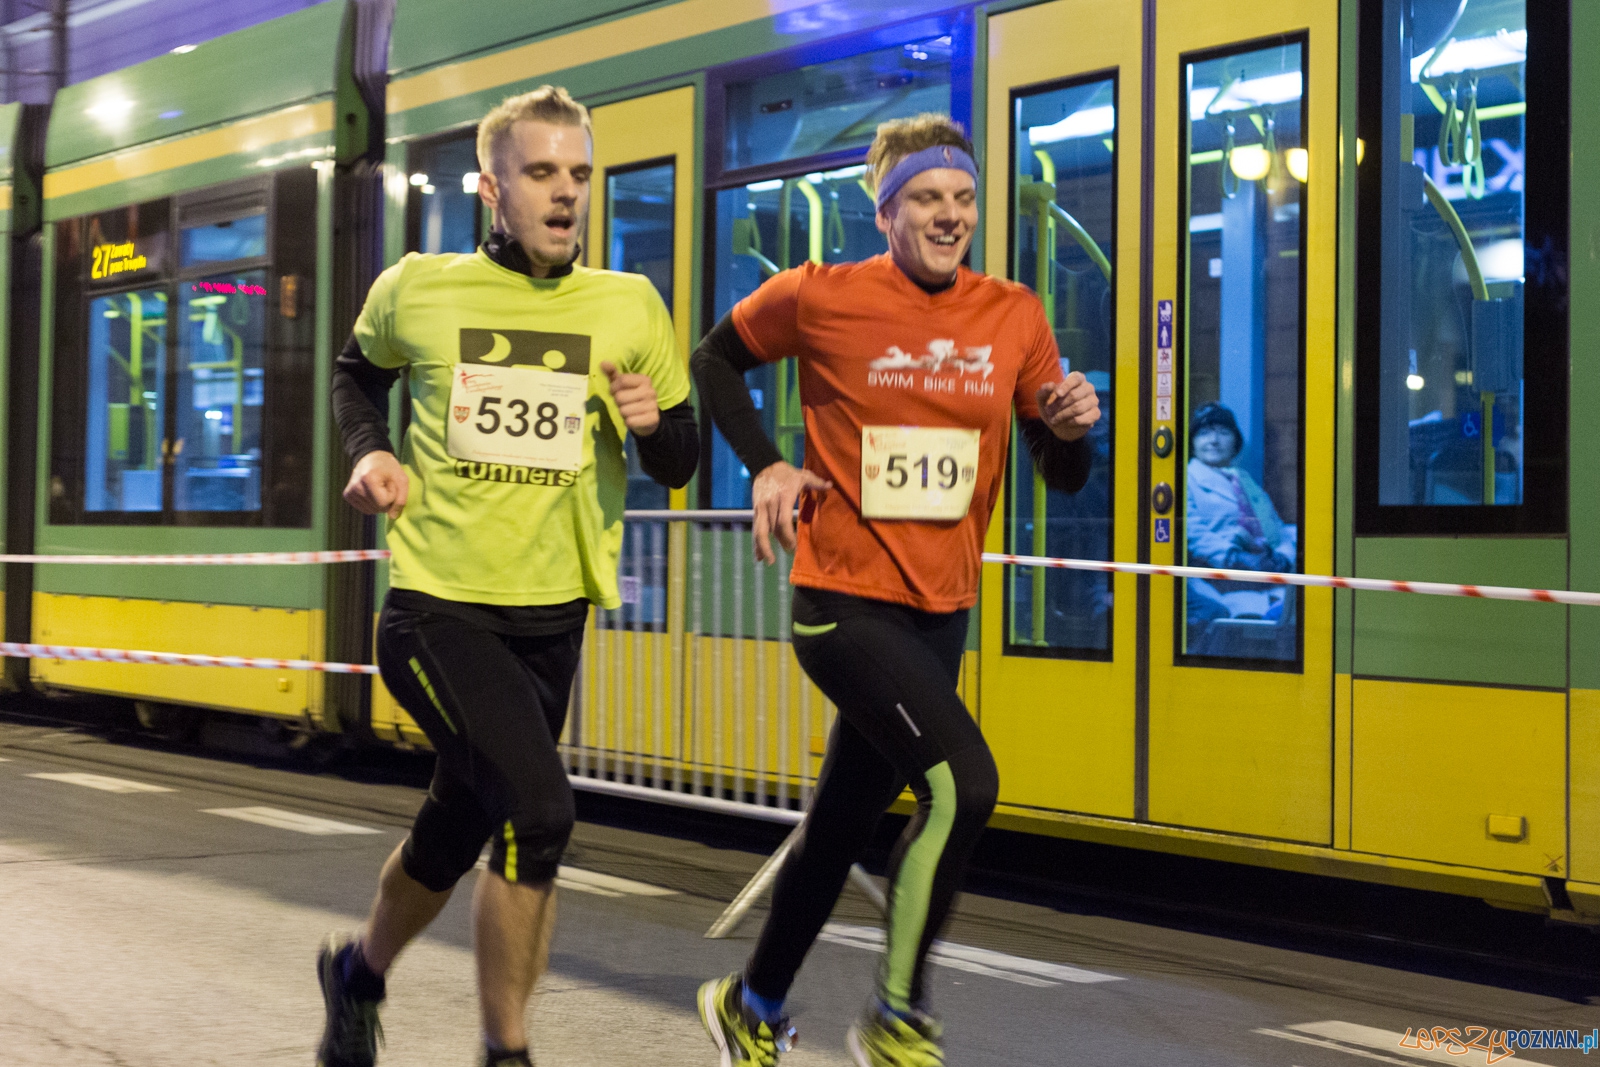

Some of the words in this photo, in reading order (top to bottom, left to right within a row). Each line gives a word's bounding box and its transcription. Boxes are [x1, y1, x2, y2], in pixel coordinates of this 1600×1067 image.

[91, 243, 111, 280] 27
[867, 371, 914, 389] SWIM
[923, 376, 955, 395] BIKE
[964, 379, 994, 397] RUN
[474, 395, 559, 441] 538
[456, 460, 577, 487] runners
[886, 453, 958, 490] 519
